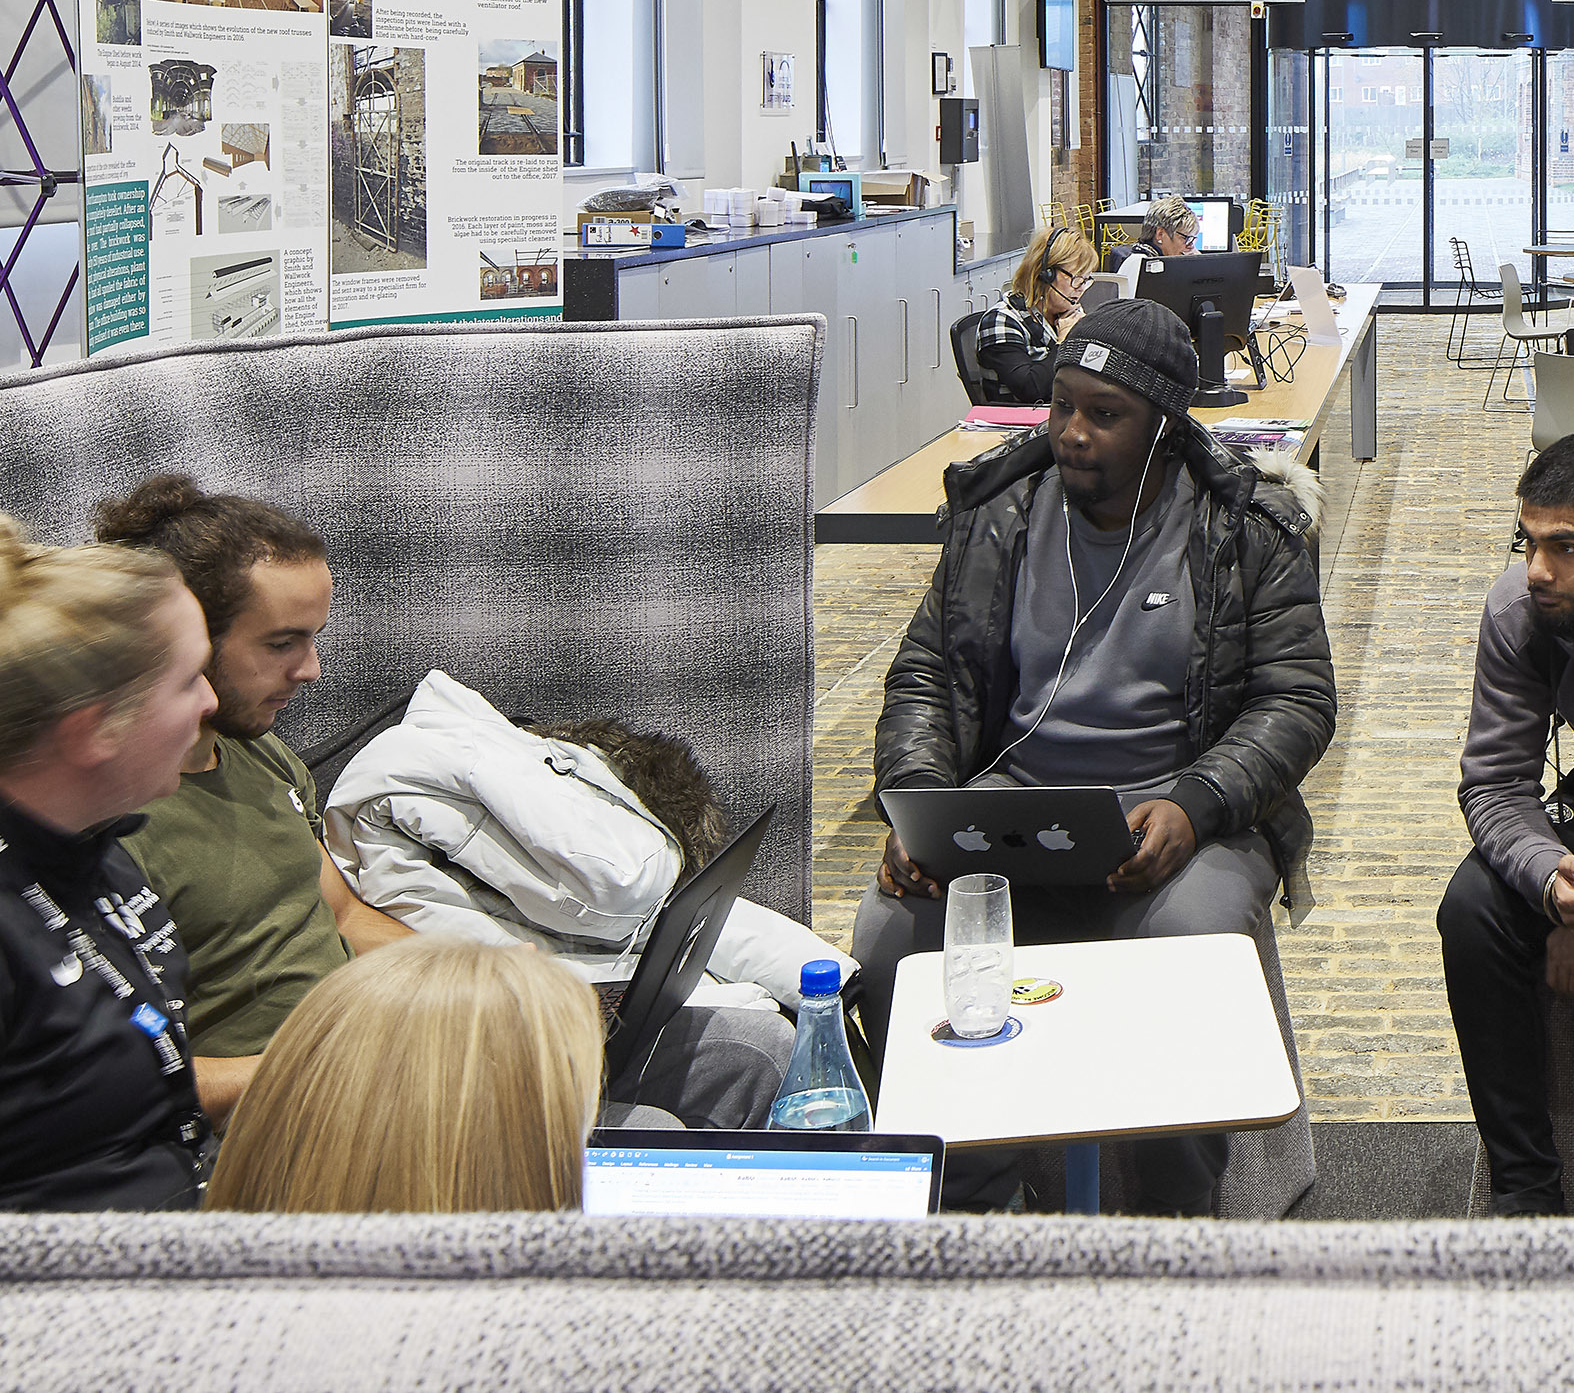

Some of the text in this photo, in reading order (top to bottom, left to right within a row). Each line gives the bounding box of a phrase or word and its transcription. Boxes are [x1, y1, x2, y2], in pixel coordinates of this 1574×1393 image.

[117, 188, 145, 200] ownership
[138, 290, 146, 302] by
[544, 312, 562, 322] and
[1146, 592, 1170, 604] NIKE
